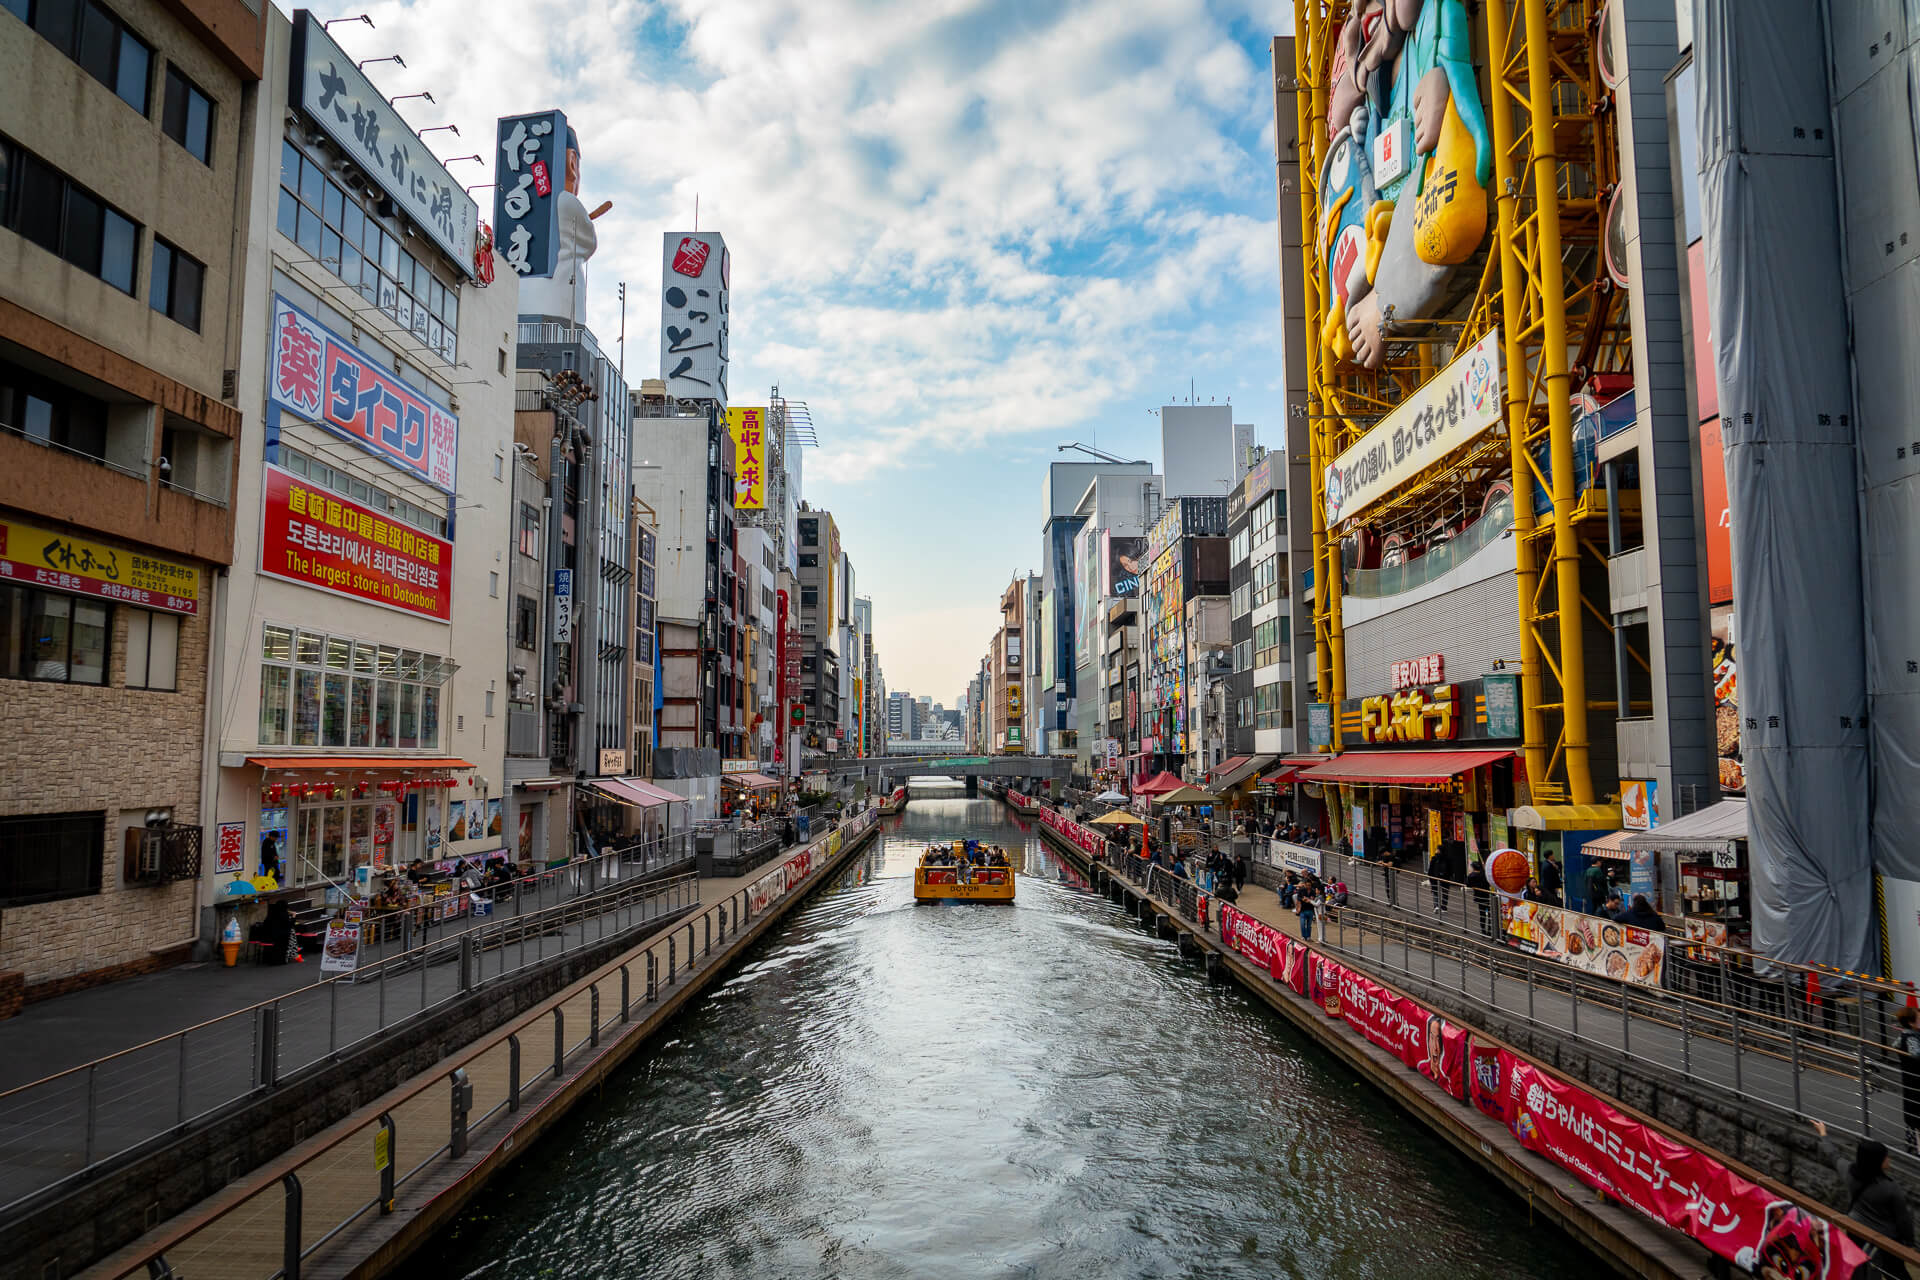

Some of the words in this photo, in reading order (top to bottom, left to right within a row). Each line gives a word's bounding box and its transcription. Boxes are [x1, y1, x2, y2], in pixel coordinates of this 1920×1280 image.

[502, 121, 552, 273] だるま
[281, 312, 321, 409] 薬
[331, 359, 426, 460] ダイコク
[432, 411, 455, 457] 免税
[740, 409, 760, 505] 高収入求人
[433, 465, 450, 487] FREE
[436, 452, 449, 470] TAX
[287, 519, 371, 569] 도톤보리에서
[373, 549, 438, 589] 최대급인점포
[36, 569, 81, 589] たこ焼き
[101, 583, 150, 602] お好み焼き
[286, 549, 308, 574] The
[312, 557, 350, 586] largest
[353, 572, 379, 594] store
[382, 579, 391, 598] in
[393, 583, 438, 612] Dotonbori.
[558, 571, 569, 594] 焼肉
[557, 596, 569, 641] いろりや
[220, 826, 241, 867] 薬
[1526, 1082, 1741, 1233] 飴ちゃんはコミュニケーション
